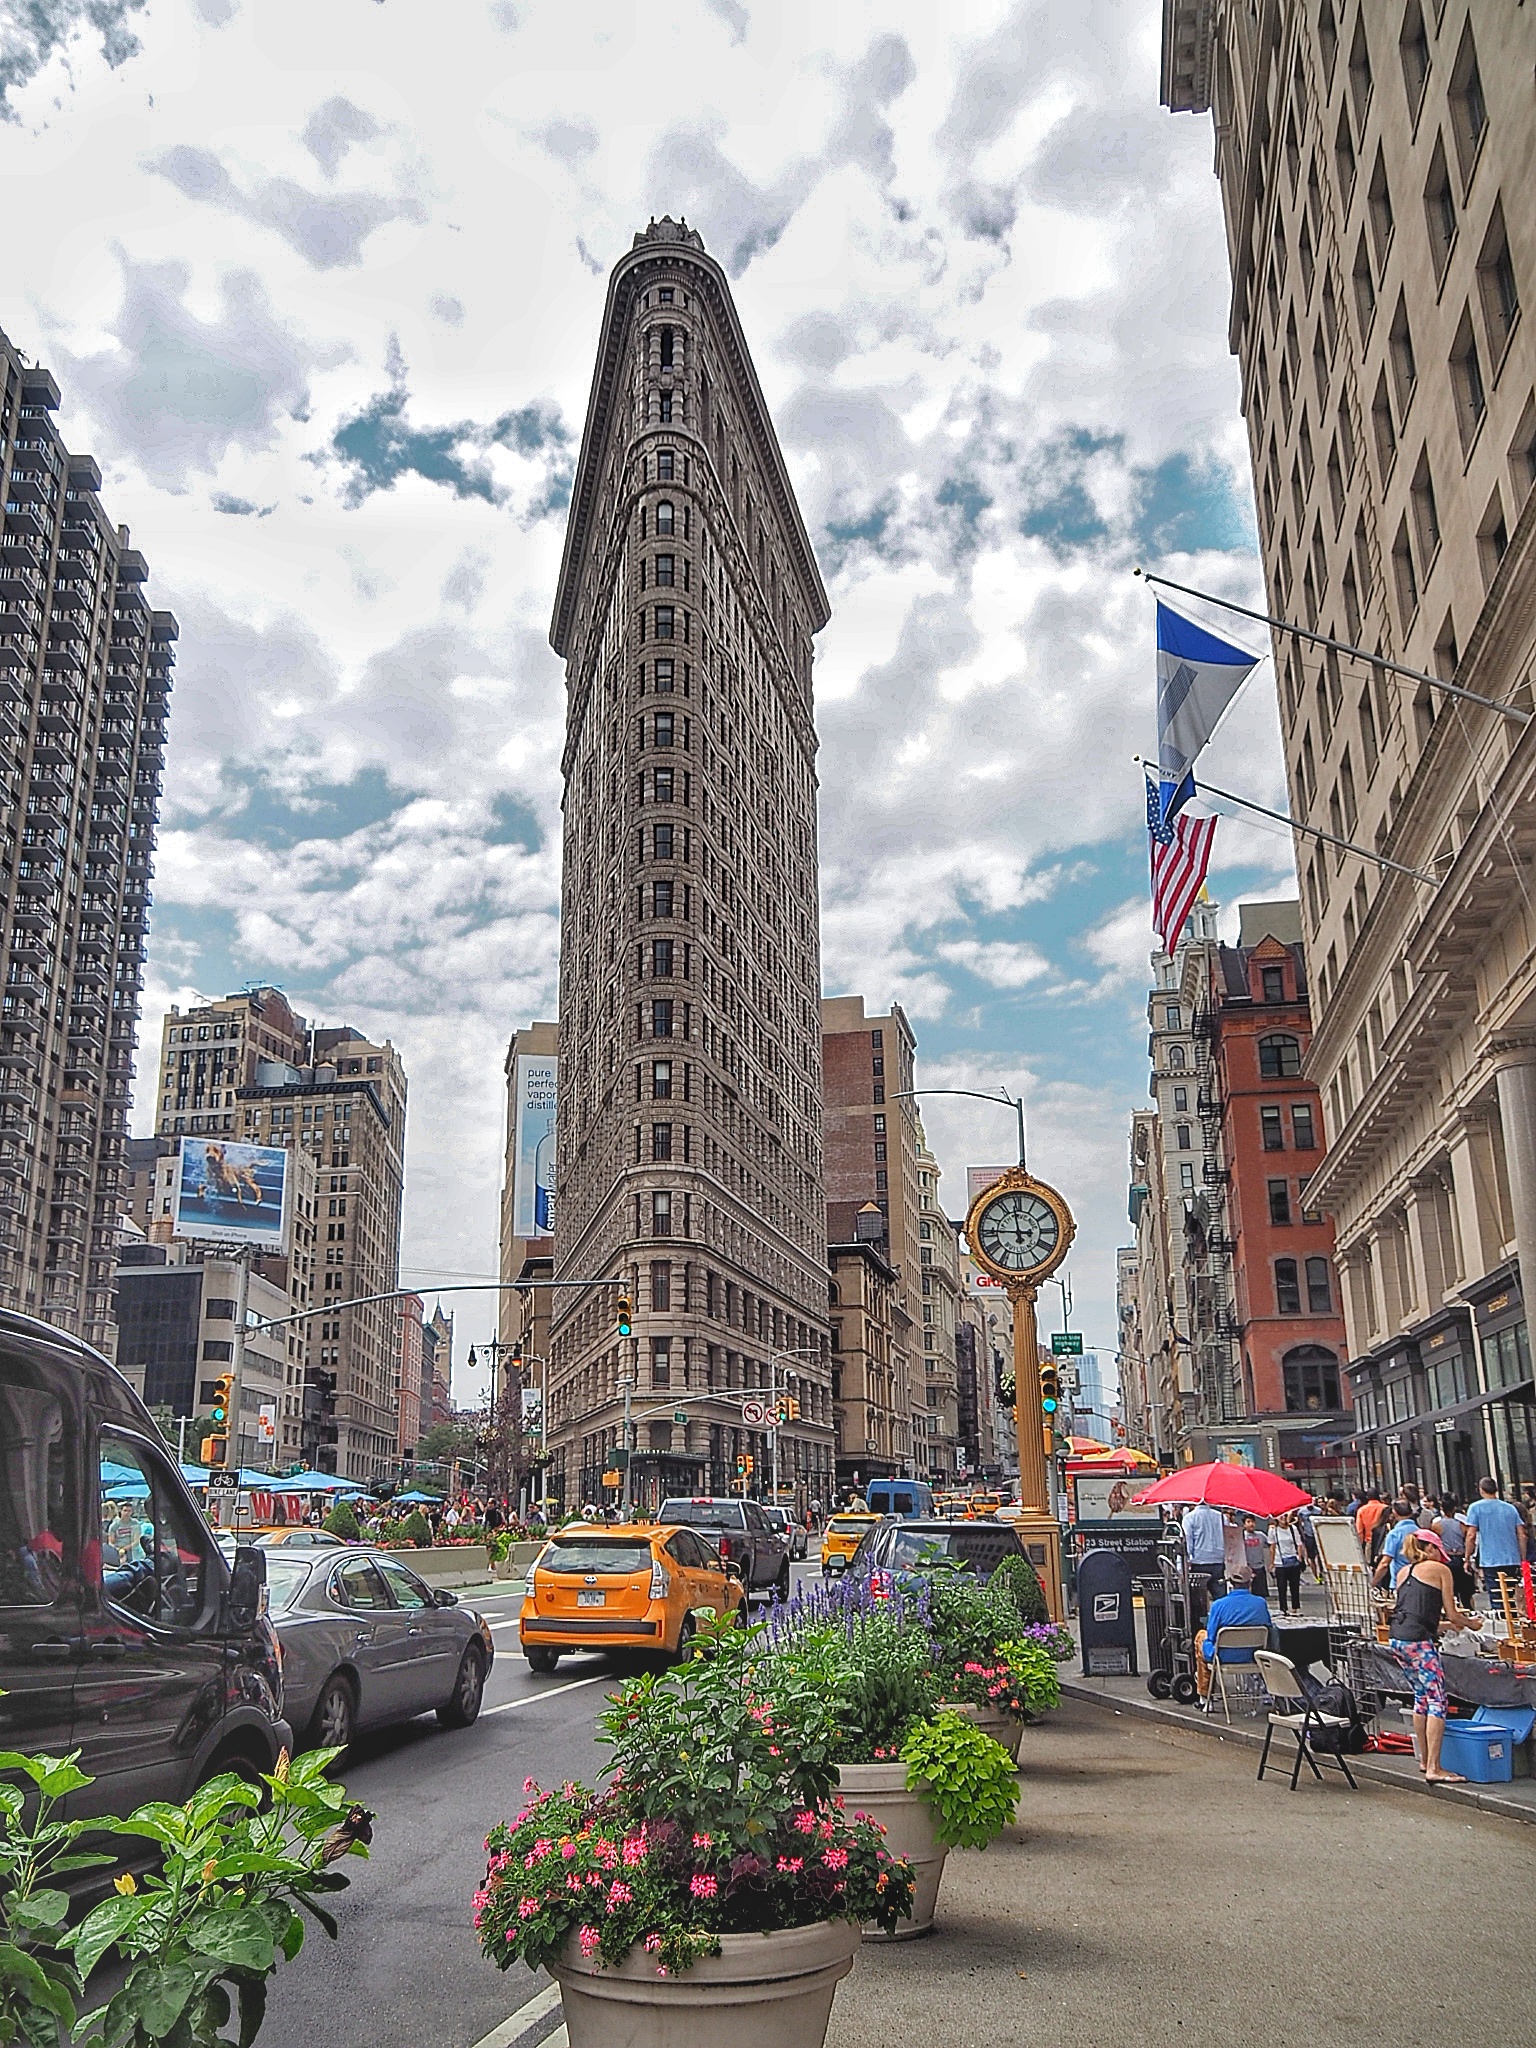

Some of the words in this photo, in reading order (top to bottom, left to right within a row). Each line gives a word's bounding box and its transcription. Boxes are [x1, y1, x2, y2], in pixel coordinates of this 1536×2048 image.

[528, 1069, 551, 1078] pure
[528, 1091, 557, 1100] vapor
[1004, 1241, 1036, 1253] BUILDING
[1126, 1538, 1154, 1546] Station
